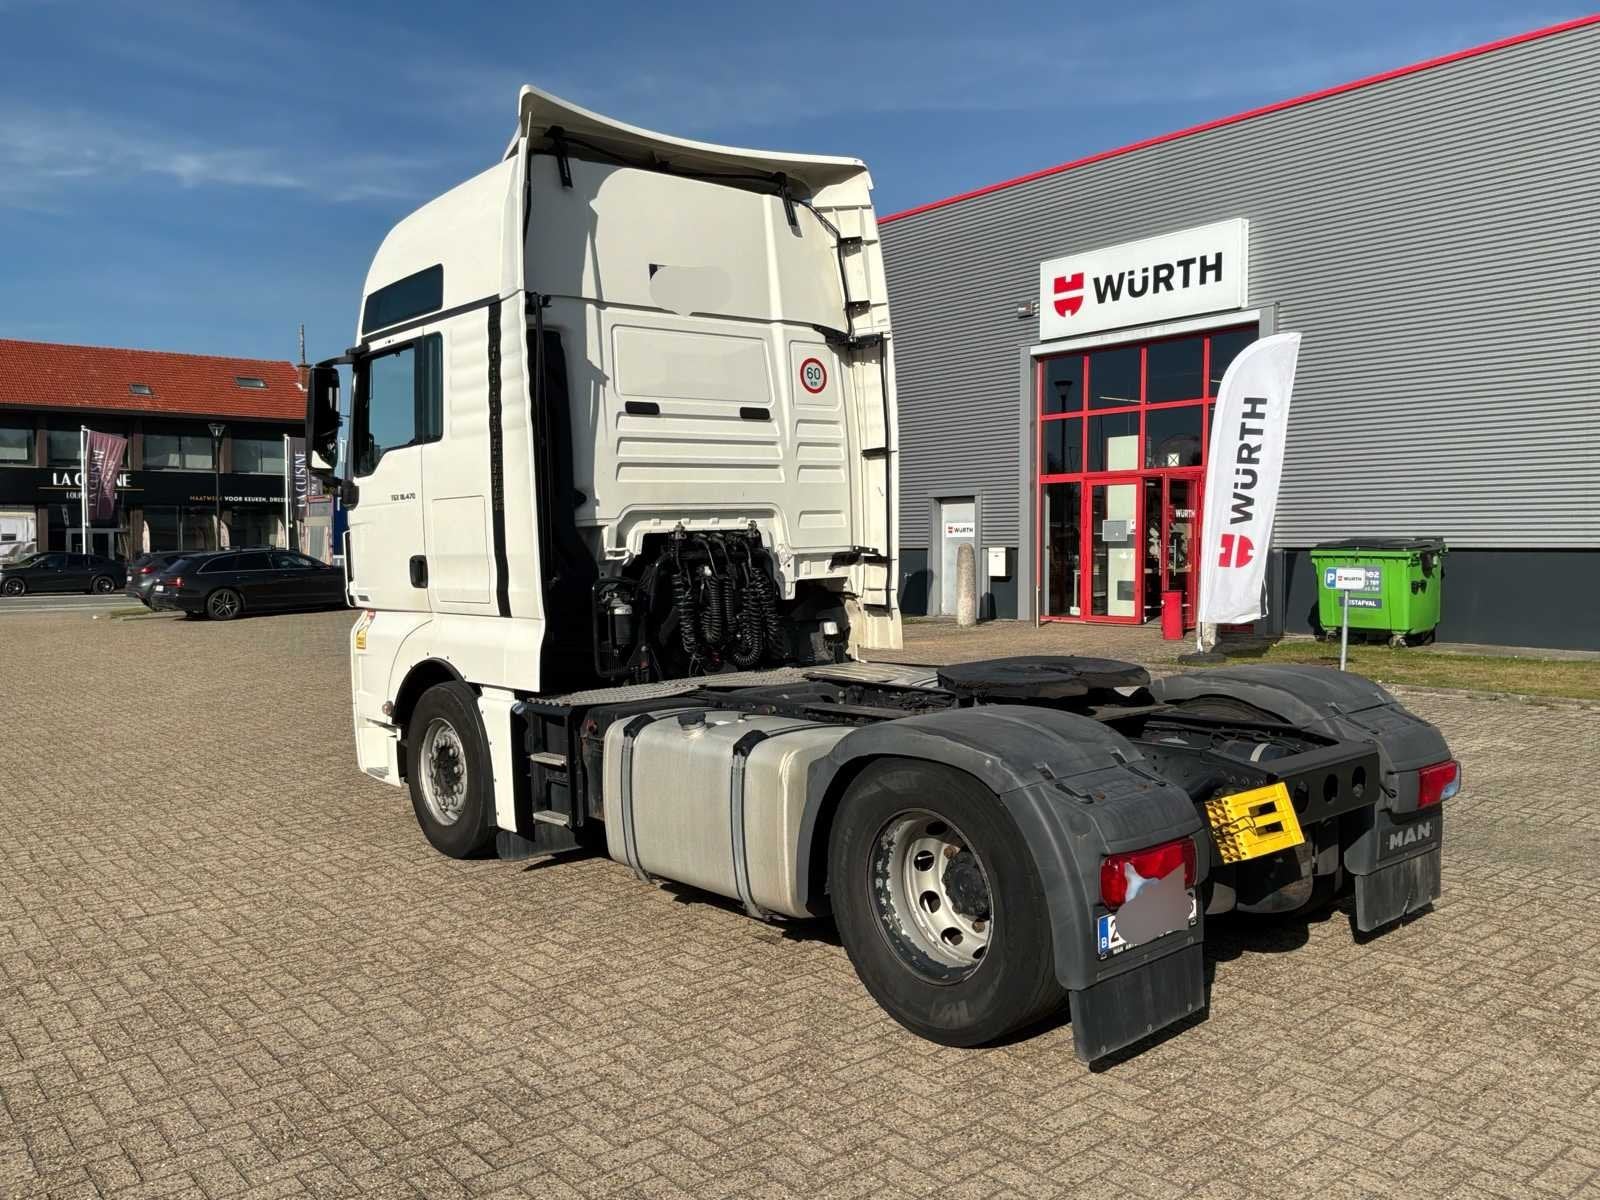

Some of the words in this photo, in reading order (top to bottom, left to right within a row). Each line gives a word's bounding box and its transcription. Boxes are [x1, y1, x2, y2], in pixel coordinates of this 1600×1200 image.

[1093, 252, 1222, 304] WÜRTH
[806, 367, 820, 380] 60
[295, 450, 306, 492] CUISINE
[1230, 397, 1267, 525] WÜRTH
[52, 472, 71, 486] LA
[296, 494, 307, 507] LA
[1389, 821, 1430, 850] MAN
[1101, 936, 1108, 949] B
